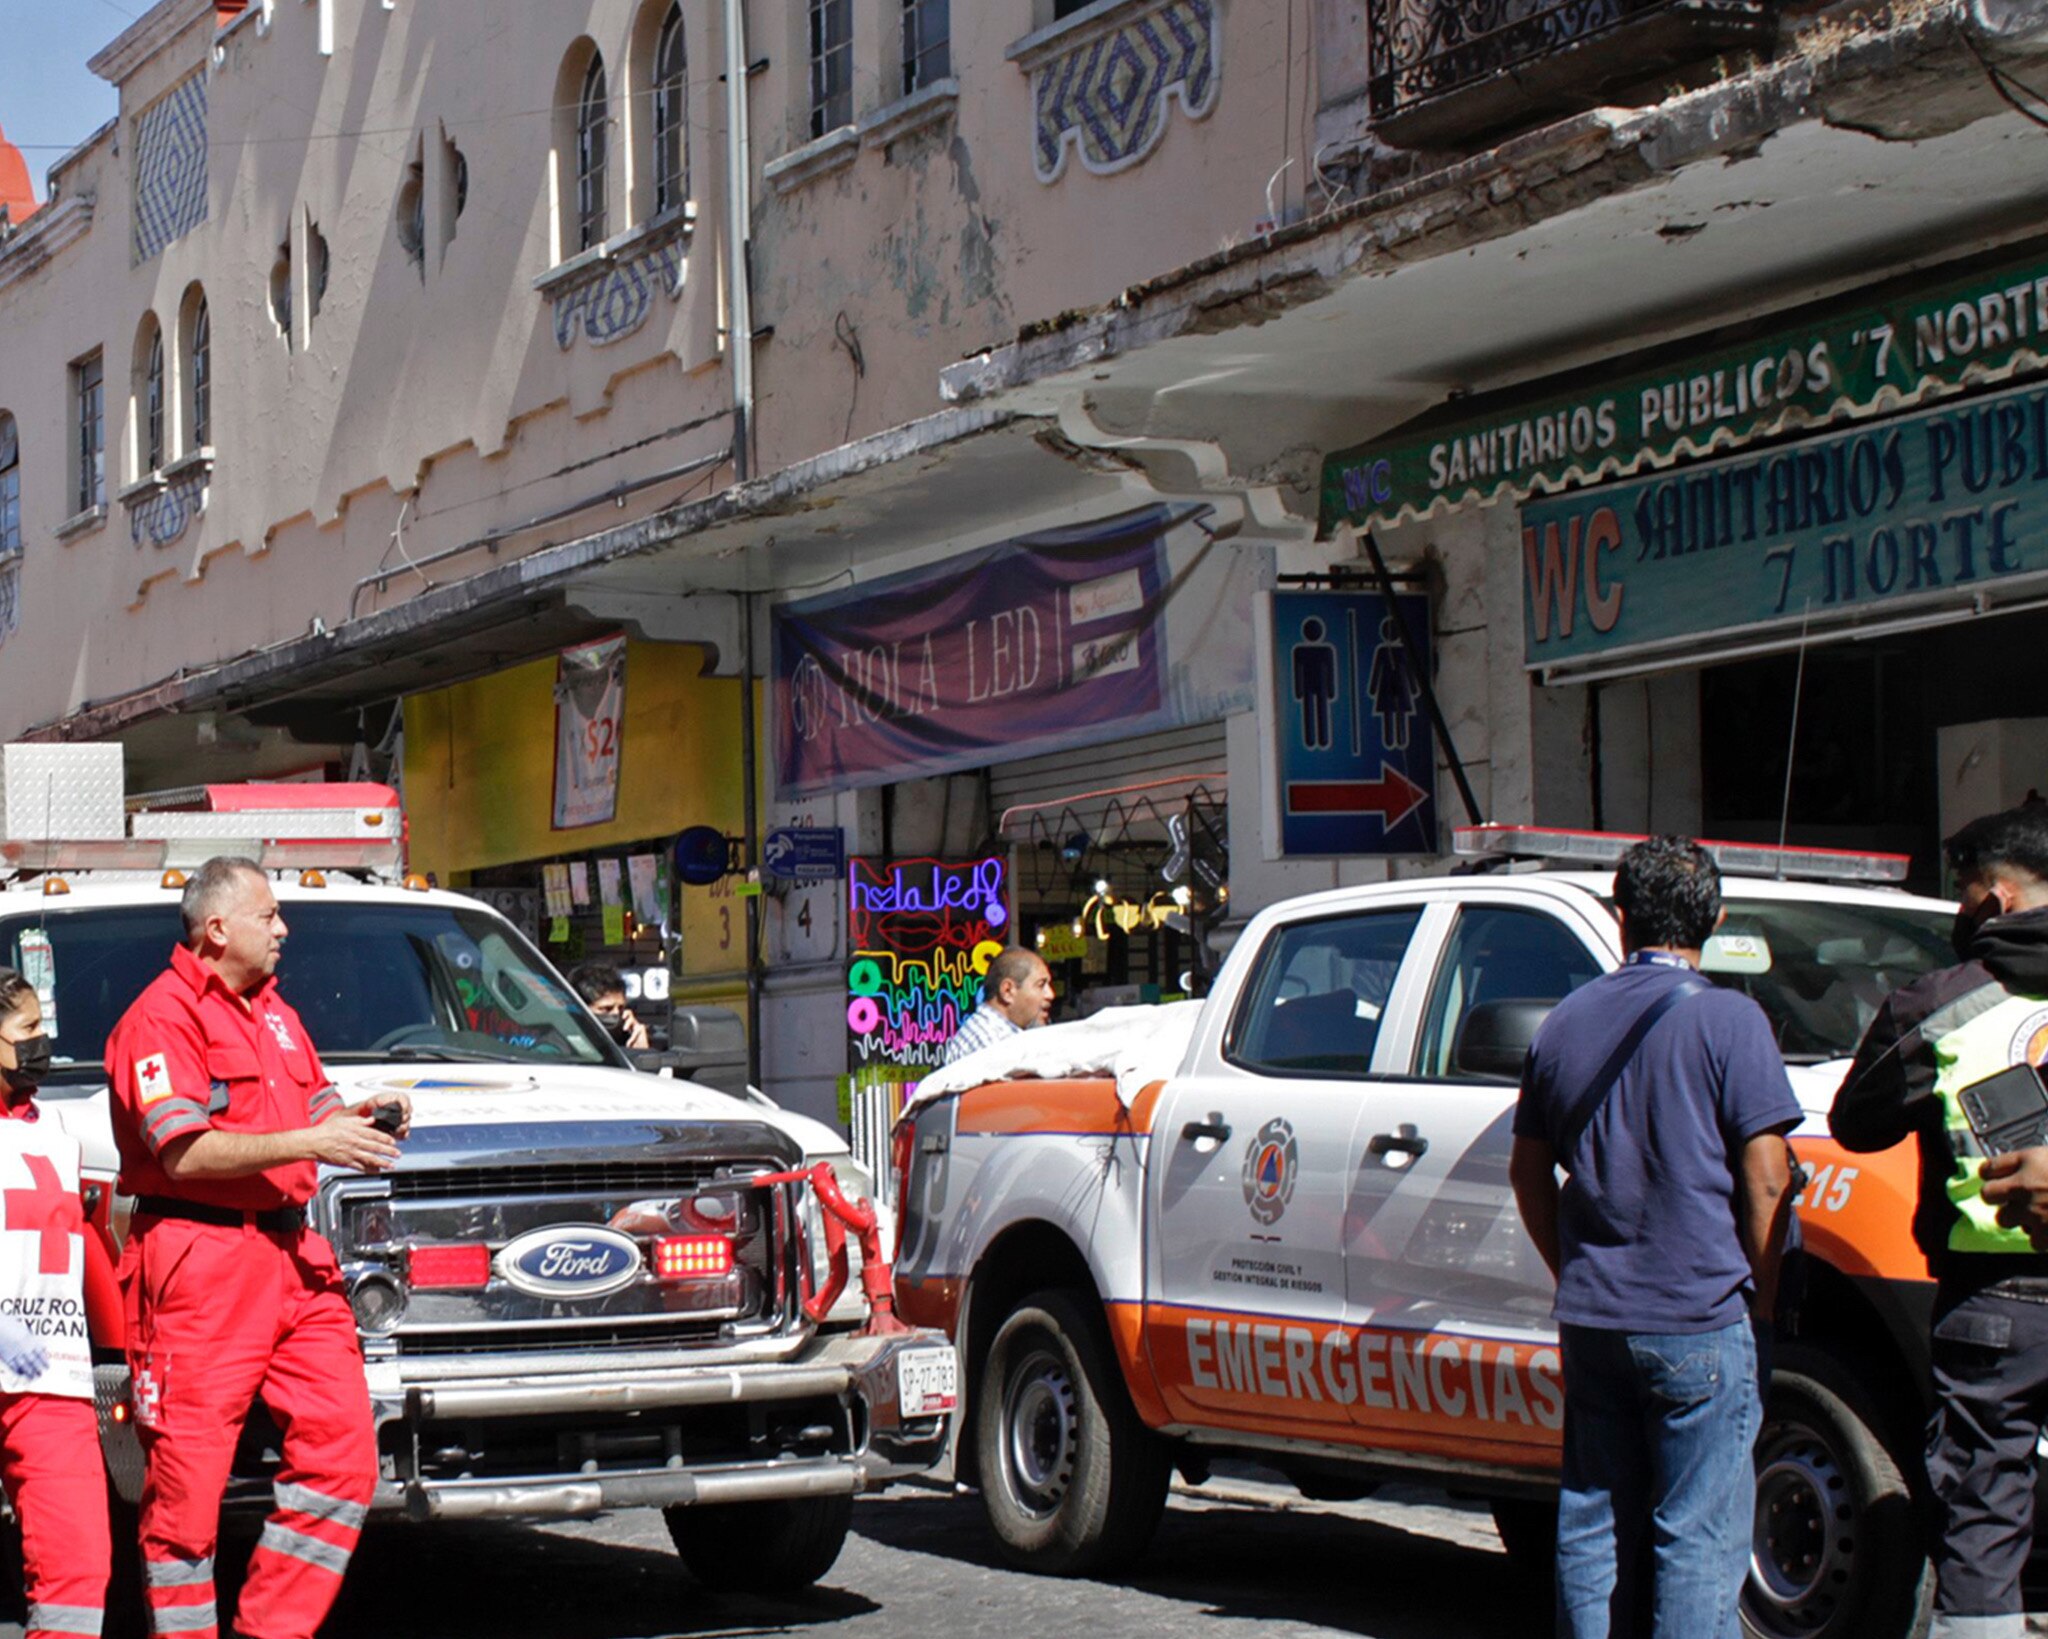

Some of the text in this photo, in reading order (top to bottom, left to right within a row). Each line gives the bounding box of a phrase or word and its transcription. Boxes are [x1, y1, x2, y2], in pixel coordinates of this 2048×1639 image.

[1343, 458, 1392, 511] WC
[1428, 400, 1616, 490] SANITARIOS
[1641, 341, 1833, 438] PUBLICOS
[1634, 427, 1905, 563] SANITARIOS
[1522, 506, 1624, 642] WC
[1763, 499, 2022, 614] 7 NORTE
[839, 632, 940, 730] HOLA
[965, 604, 1042, 704] LED
[719, 905, 731, 950] 3
[797, 898, 812, 938] 4
[540, 1243, 608, 1276] Ford
[1276, 1262, 1296, 1276] CIVIL
[1245, 1273, 1279, 1288] INTEGRAL
[1280, 1277, 1289, 1289] DE
[1291, 1279, 1322, 1293] RIESGOS
[0, 1298, 44, 1316] CRUZ
[18, 1318, 85, 1338] XICAN
[1186, 1318, 1564, 1430] EMERGENCIAS
